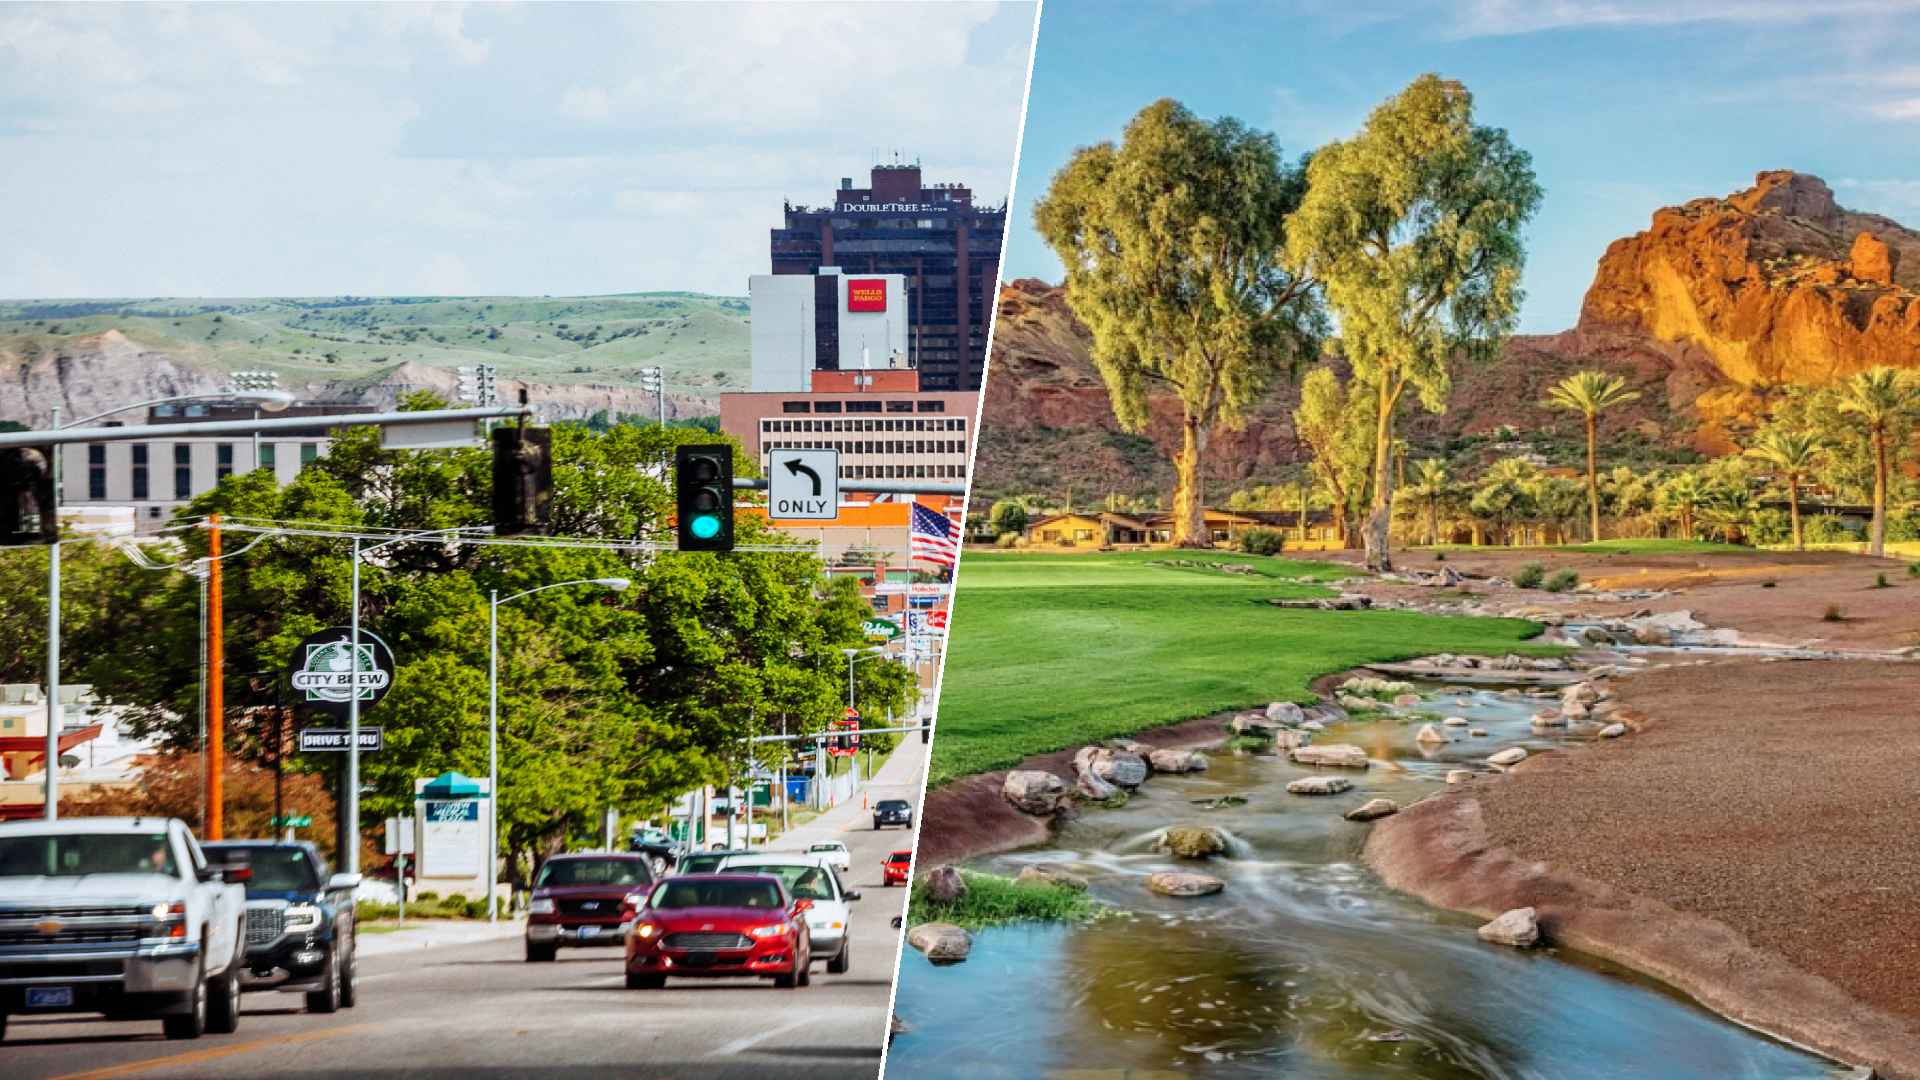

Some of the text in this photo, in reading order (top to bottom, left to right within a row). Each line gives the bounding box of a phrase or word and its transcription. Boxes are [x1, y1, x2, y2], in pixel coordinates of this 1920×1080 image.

[778, 499, 828, 513] ONLY
[297, 675, 333, 685] CITY
[303, 734, 376, 746] DRIVE TRU
